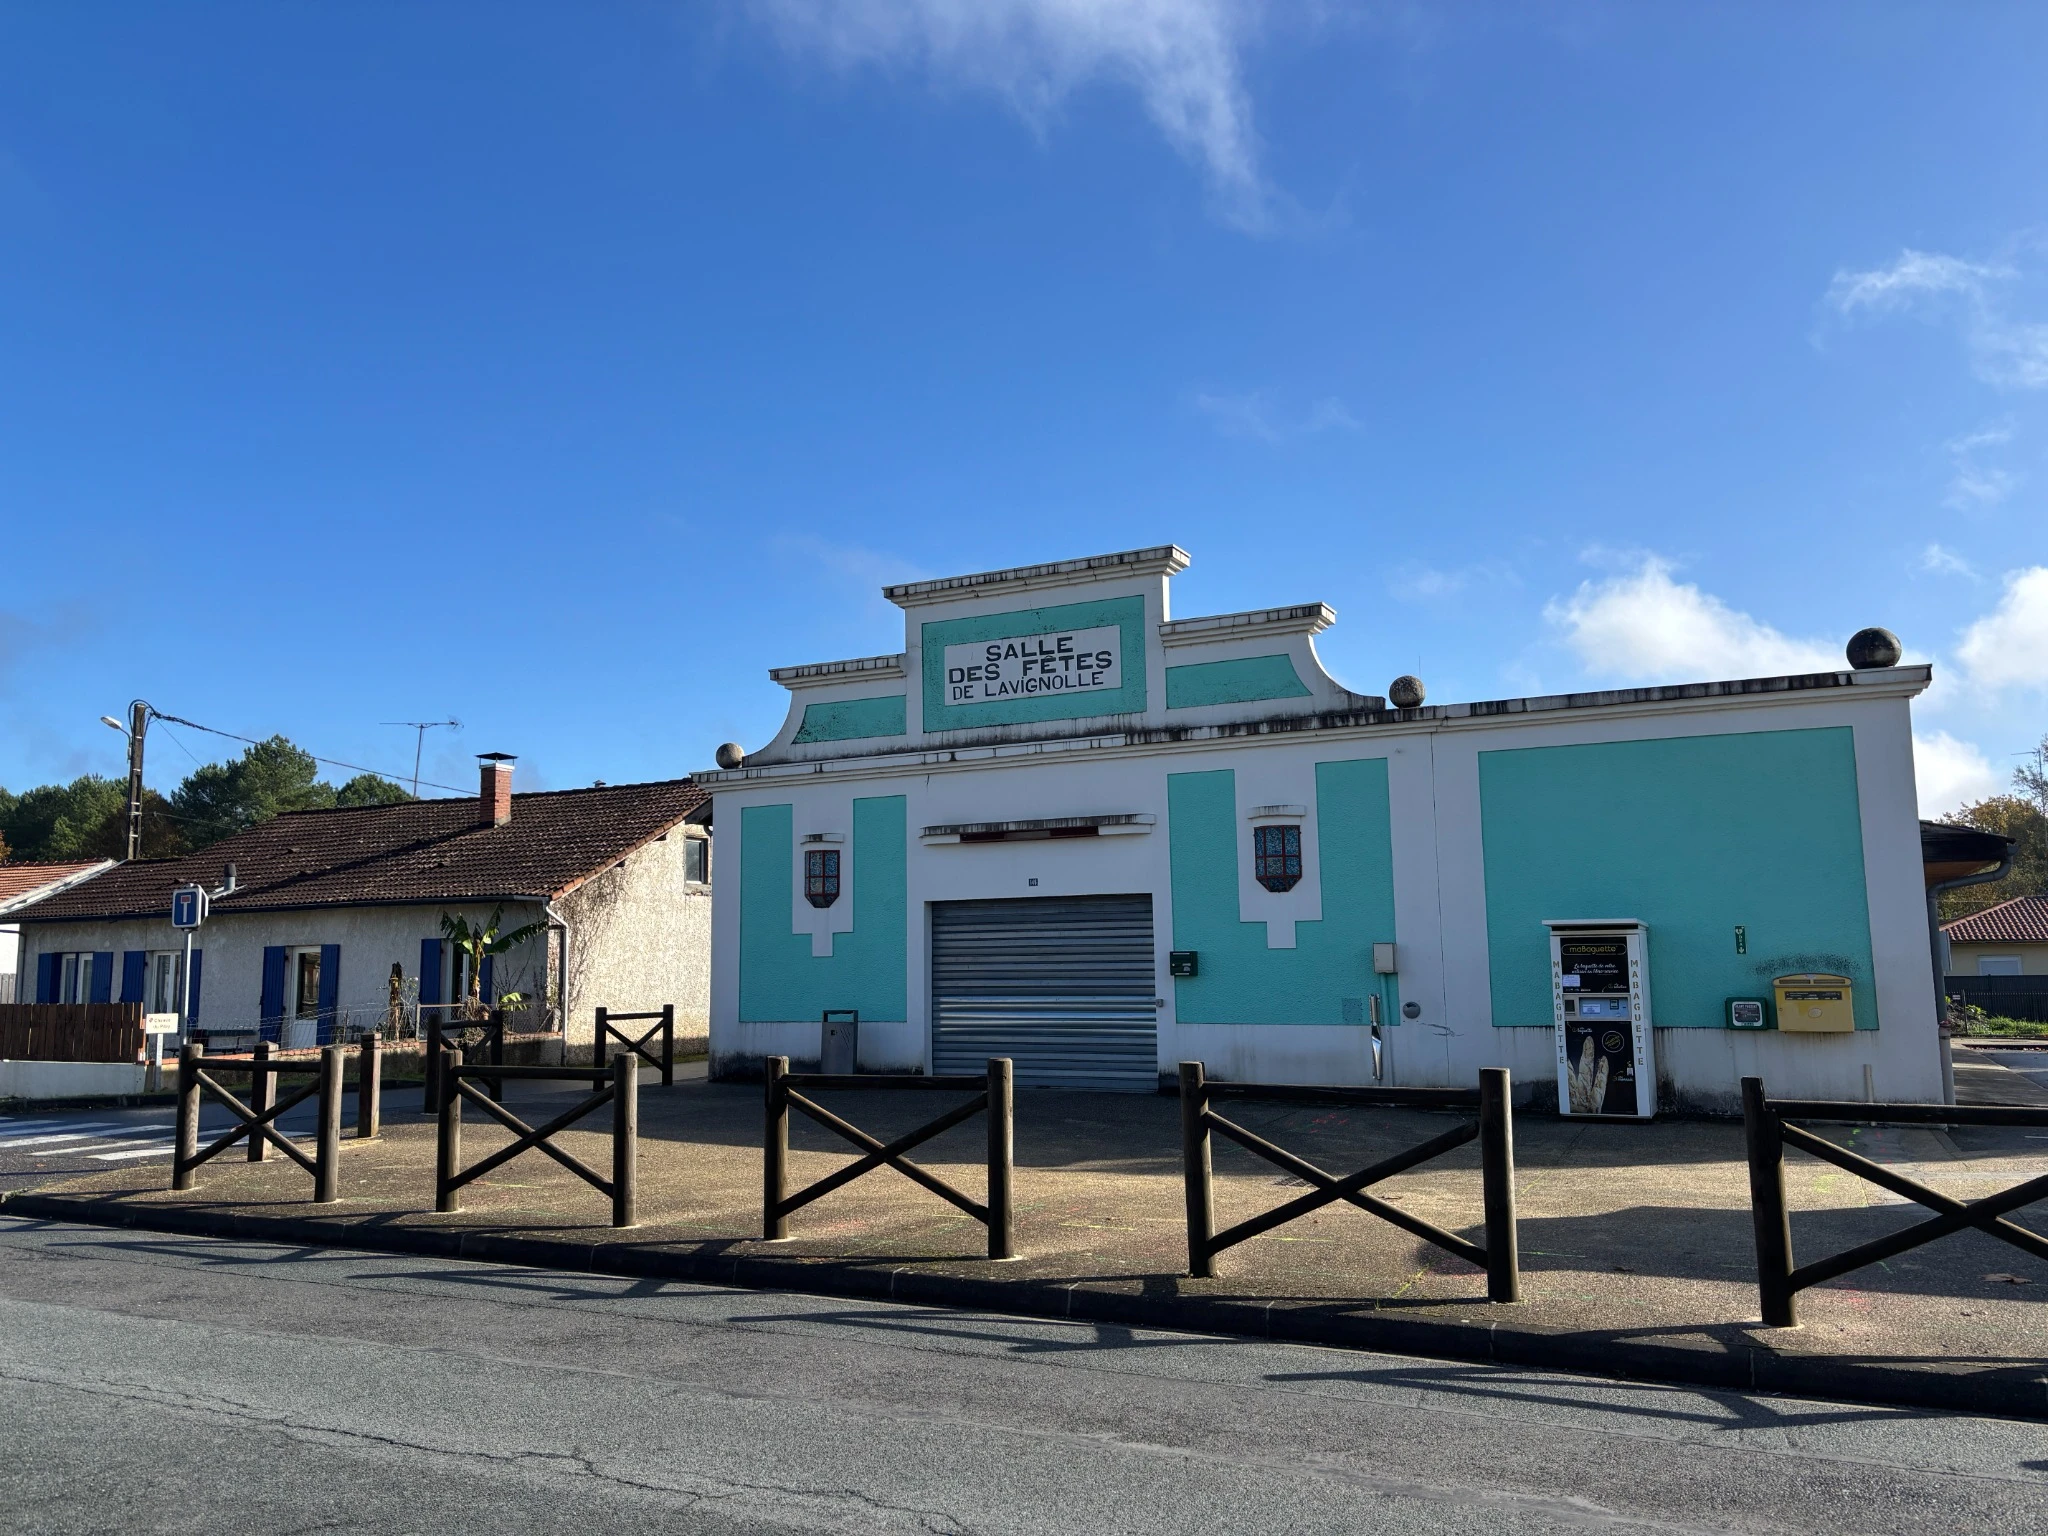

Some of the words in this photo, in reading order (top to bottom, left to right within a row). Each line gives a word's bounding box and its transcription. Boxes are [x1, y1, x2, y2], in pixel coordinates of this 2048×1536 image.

[986, 636, 1074, 662] SALLE
[949, 663, 1001, 685] DES
[1022, 651, 1113, 677] FÊTES
[952, 685, 974, 701] DE
[1553, 961, 1565, 1064] MABAGUETTE
[1631, 960, 1644, 1066] MABAGUETTE
